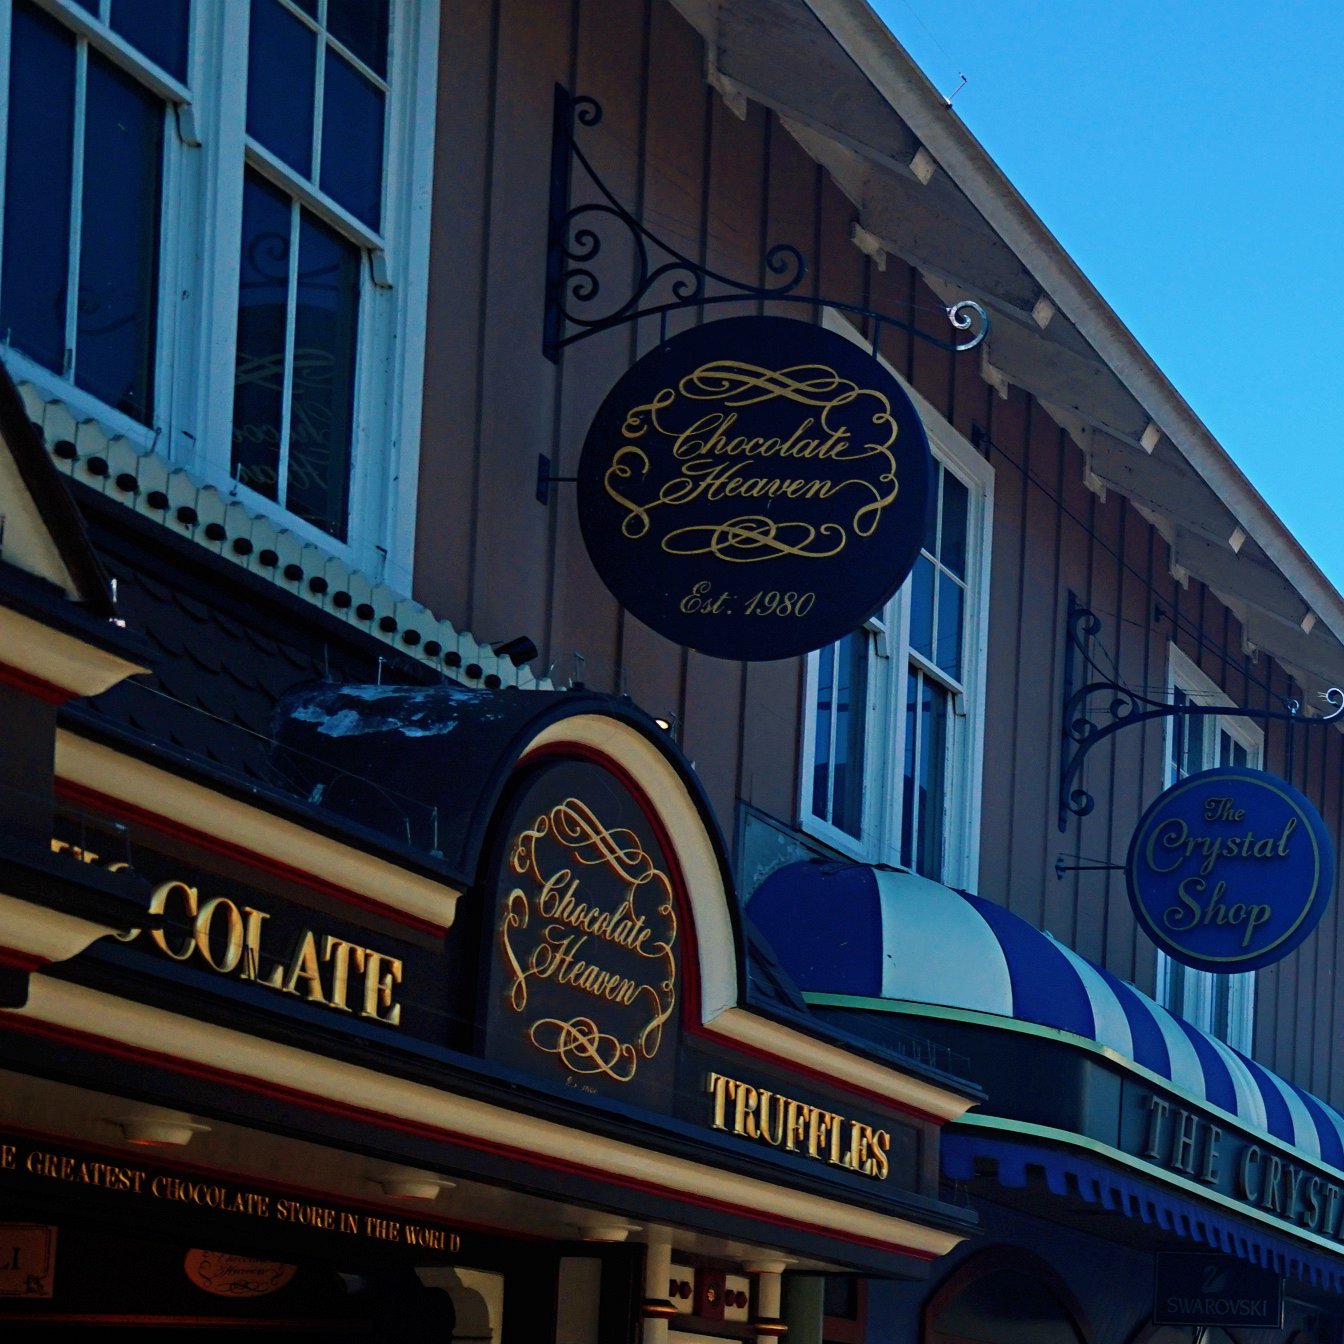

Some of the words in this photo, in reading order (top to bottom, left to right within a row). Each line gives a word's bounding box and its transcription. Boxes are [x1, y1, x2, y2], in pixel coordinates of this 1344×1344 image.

[673, 412, 852, 460] Chocolate
[661, 459, 833, 504] Heaven
[744, 591, 816, 617] 1980
[1203, 797, 1246, 822] The
[1145, 817, 1298, 876] Crystal
[50, 838, 402, 1027] COLATE
[539, 869, 652, 958] Chocolate
[1163, 877, 1273, 948] Shop
[534, 923, 639, 1006] Heaven
[705, 1071, 892, 1182] TRUFFLES
[1145, 1094, 1223, 1186] THE
[25, 1150, 147, 1195] GREATEST
[151, 1175, 270, 1219] CHOCOLATE
[276, 1198, 336, 1231] STORE
[340, 1212, 359, 1235] IN
[363, 1216, 400, 1242] THE
[404, 1224, 462, 1254] WORLD
[1166, 1297, 1269, 1319] SWAROVSKI
